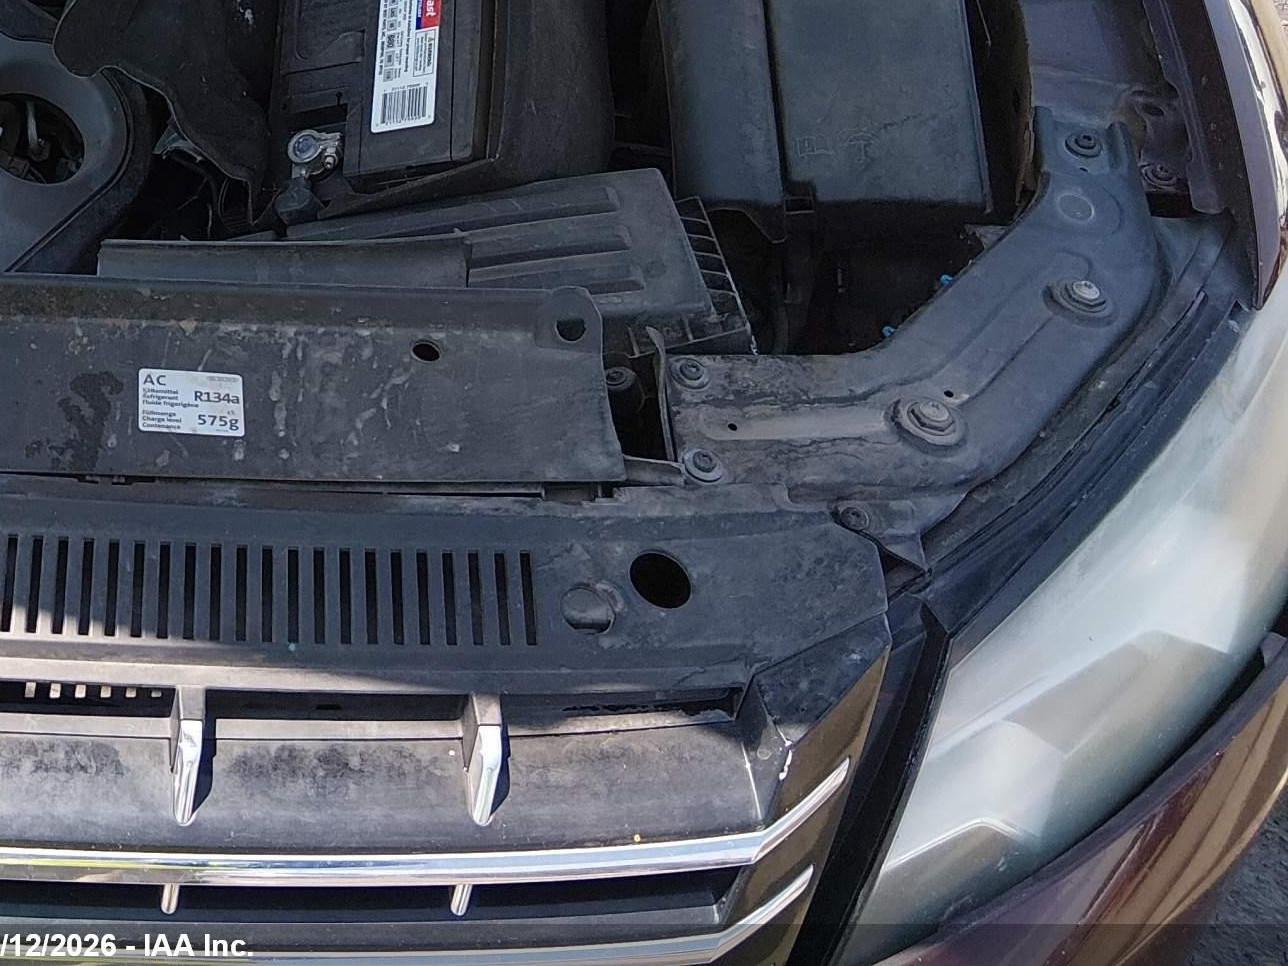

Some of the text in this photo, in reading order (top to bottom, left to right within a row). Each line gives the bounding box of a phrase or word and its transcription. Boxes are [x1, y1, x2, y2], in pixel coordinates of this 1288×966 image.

[143, 374, 167, 386] AC
[194, 390, 240, 404] R134a
[197, 414, 239, 431] 575g
